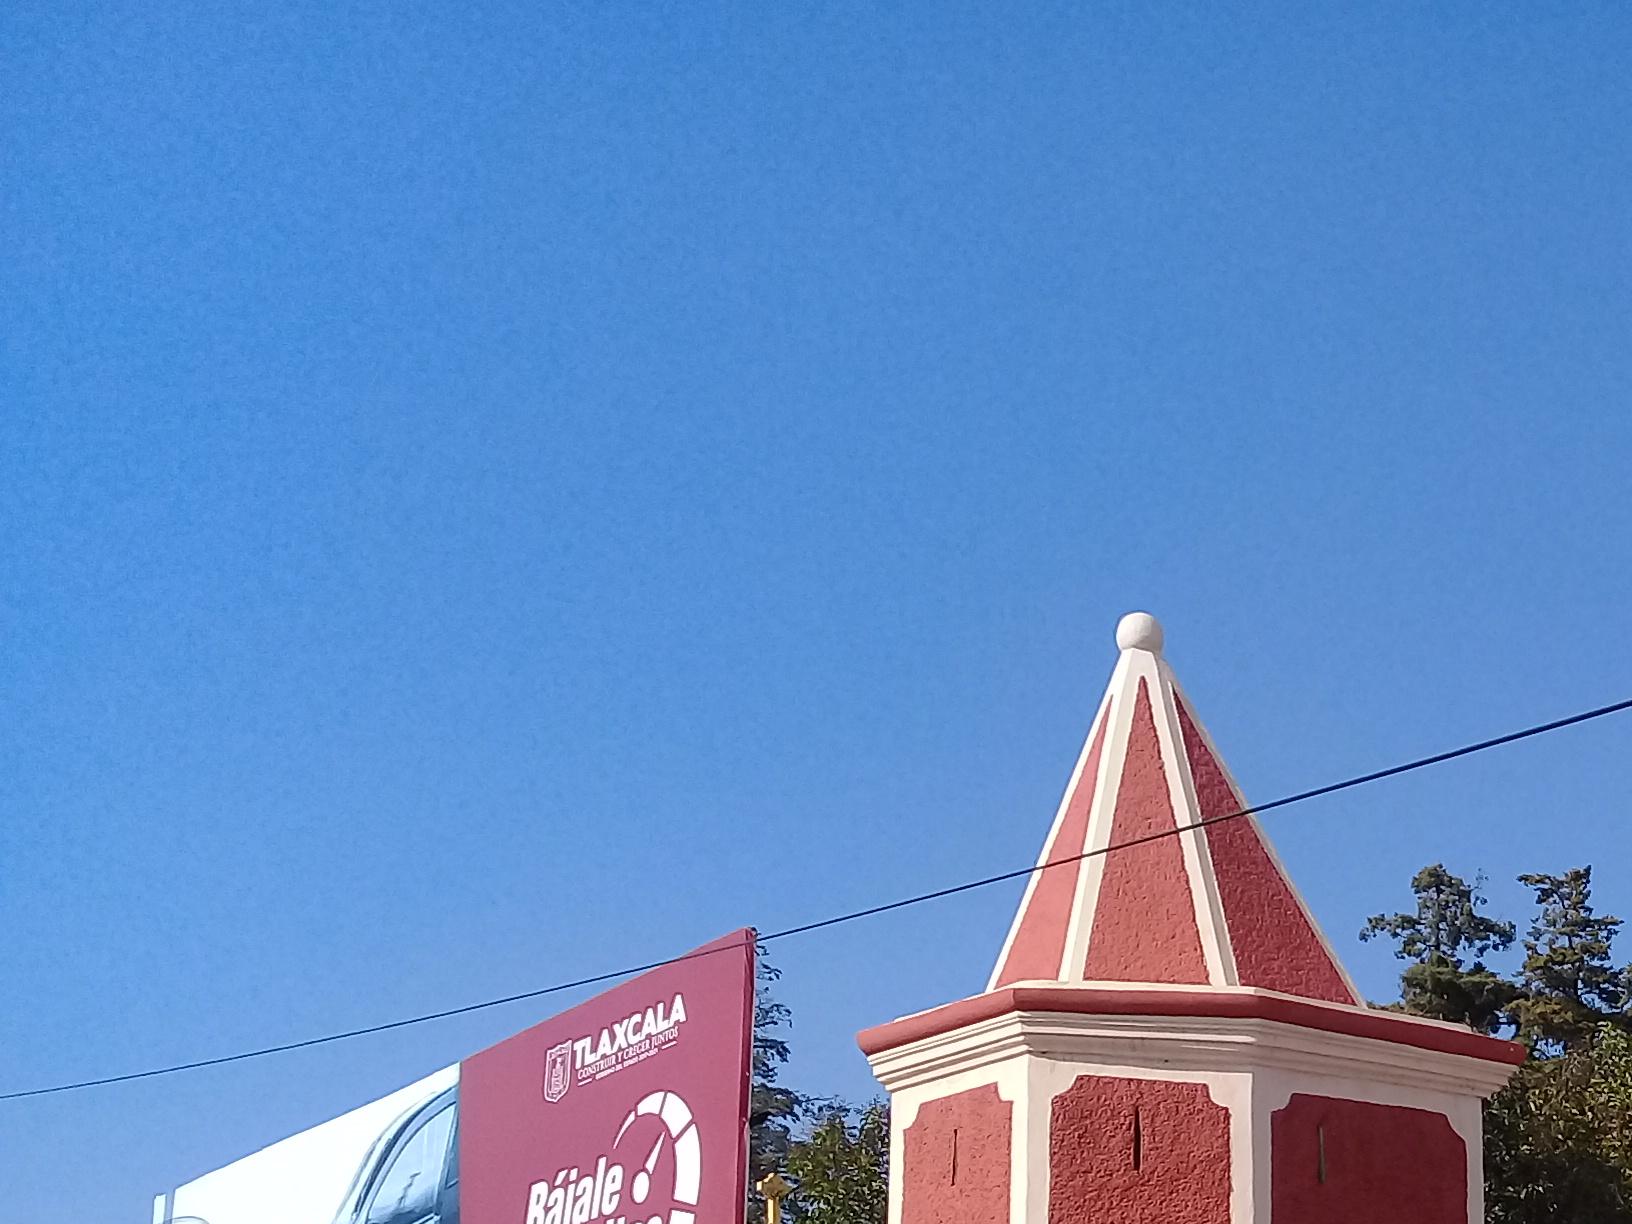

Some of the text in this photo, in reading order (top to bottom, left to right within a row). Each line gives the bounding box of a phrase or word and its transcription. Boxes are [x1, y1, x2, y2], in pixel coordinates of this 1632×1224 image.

[573, 993, 687, 1070] TLAXCALA
[577, 1055, 617, 1080] CONSTRUIR
[617, 1051, 624, 1063] Y
[623, 1039, 651, 1060] CRECER
[651, 1026, 679, 1050] JUNTOS
